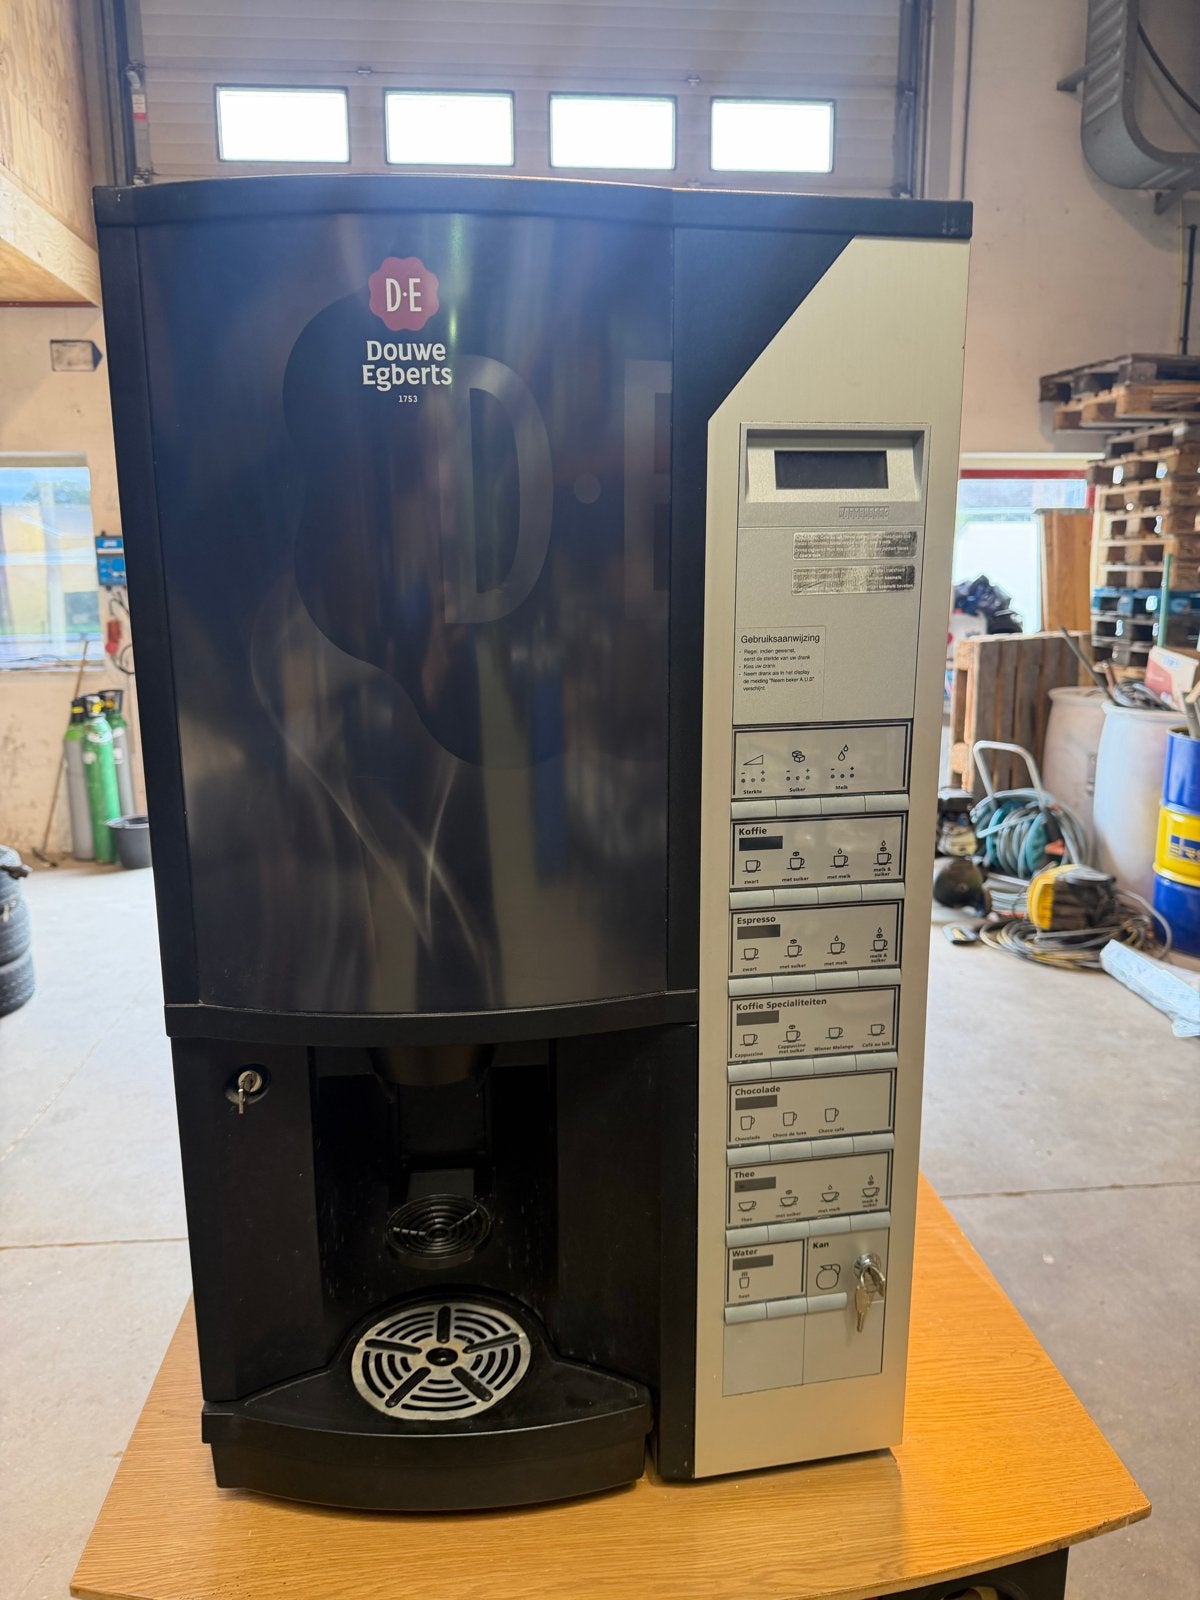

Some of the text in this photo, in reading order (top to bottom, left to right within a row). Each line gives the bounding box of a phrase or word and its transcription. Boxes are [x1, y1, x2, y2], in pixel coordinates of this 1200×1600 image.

[366, 340, 446, 361] Douwe
[362, 363, 453, 392] Egberts
[398, 395, 418, 403] 1753
[740, 634, 820, 644] Gebruiksaanwijzing
[738, 827, 767, 836] Koffie
[737, 916, 776, 926] Espresso
[736, 998, 827, 1011] Koffie Specialiteiten
[735, 1085, 781, 1096] Chocolade
[734, 1171, 755, 1179] Thee
[732, 1249, 758, 1257] Water
